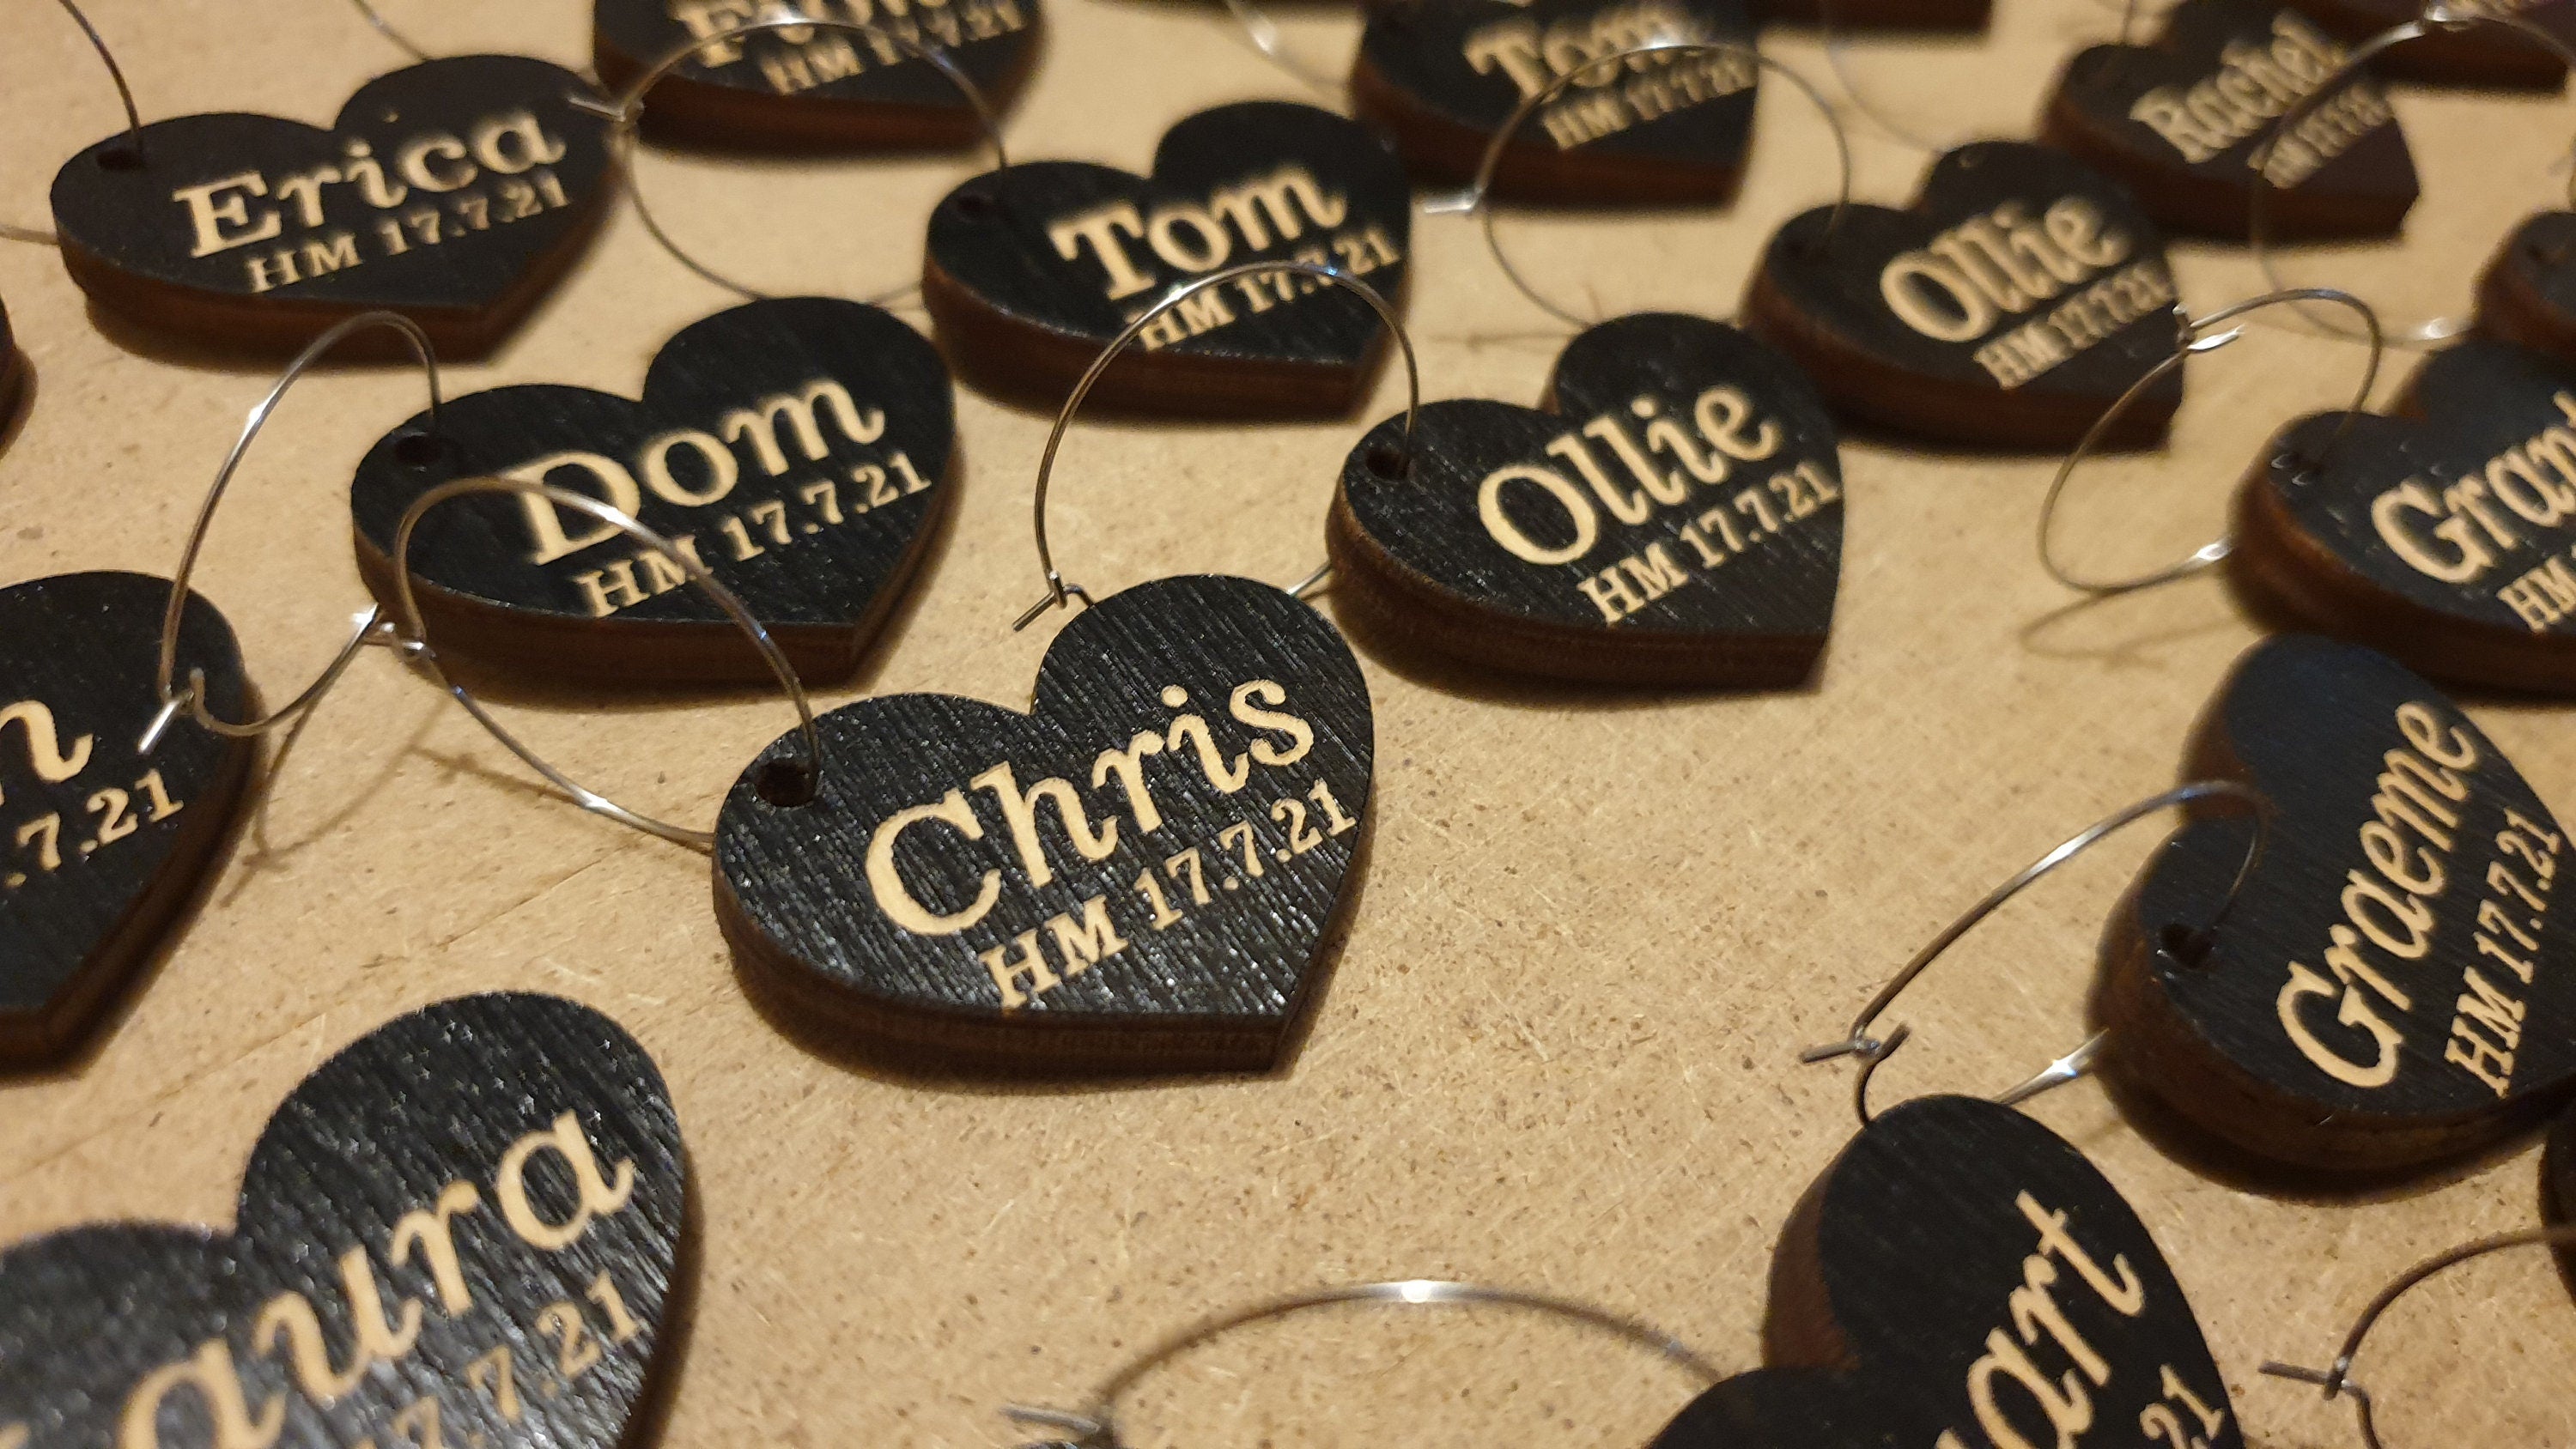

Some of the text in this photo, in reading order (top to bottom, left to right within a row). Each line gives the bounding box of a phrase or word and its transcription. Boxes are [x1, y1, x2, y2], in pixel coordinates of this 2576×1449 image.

[173, 108, 567, 258] Erica
[245, 169, 570, 294] HM 17.7.21
[1048, 167, 1347, 300] Tom
[1879, 195, 2131, 343] Ollie
[1125, 229, 1400, 351] HM 17.721
[505, 379, 885, 566] Dom
[574, 451, 933, 617] HM 17.7.21
[1478, 385, 1783, 566] Ollie
[1577, 461, 1839, 628] HM 17.7.21
[865, 680, 1315, 937] Chris
[979, 777, 1357, 1011] HM 17.7.21
[2276, 700, 2476, 1088] Graeme
[2444, 807, 2561, 1099] HM 17.7.21
[0, 1108, 635, 1449] aura
[354, 1270, 642, 1449] 7.7.21
[1933, 1189, 2145, 1449] art
